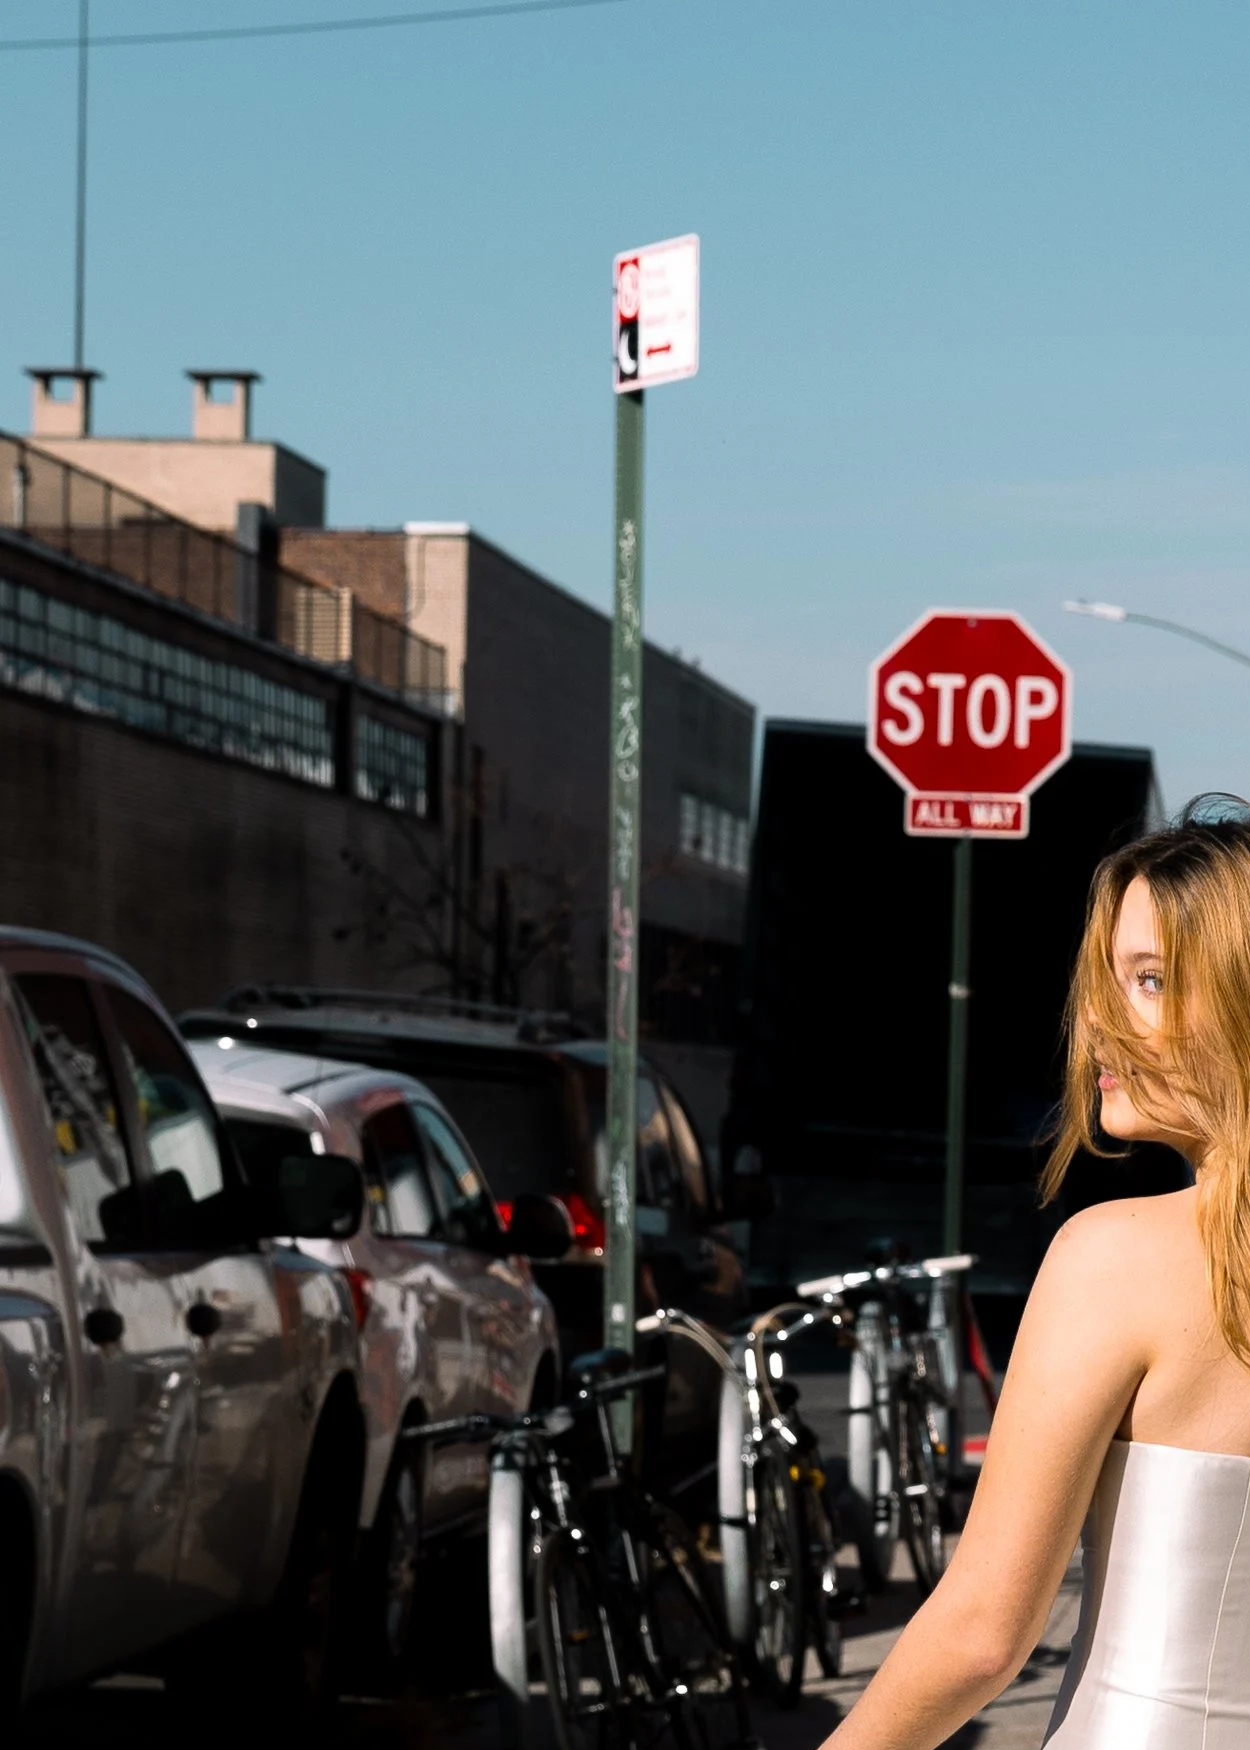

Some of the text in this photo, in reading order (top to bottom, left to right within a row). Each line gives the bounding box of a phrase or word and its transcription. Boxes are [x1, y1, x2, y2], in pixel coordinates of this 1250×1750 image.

[881, 670, 1059, 749] STOP
[914, 800, 1019, 829] ALL WAY
